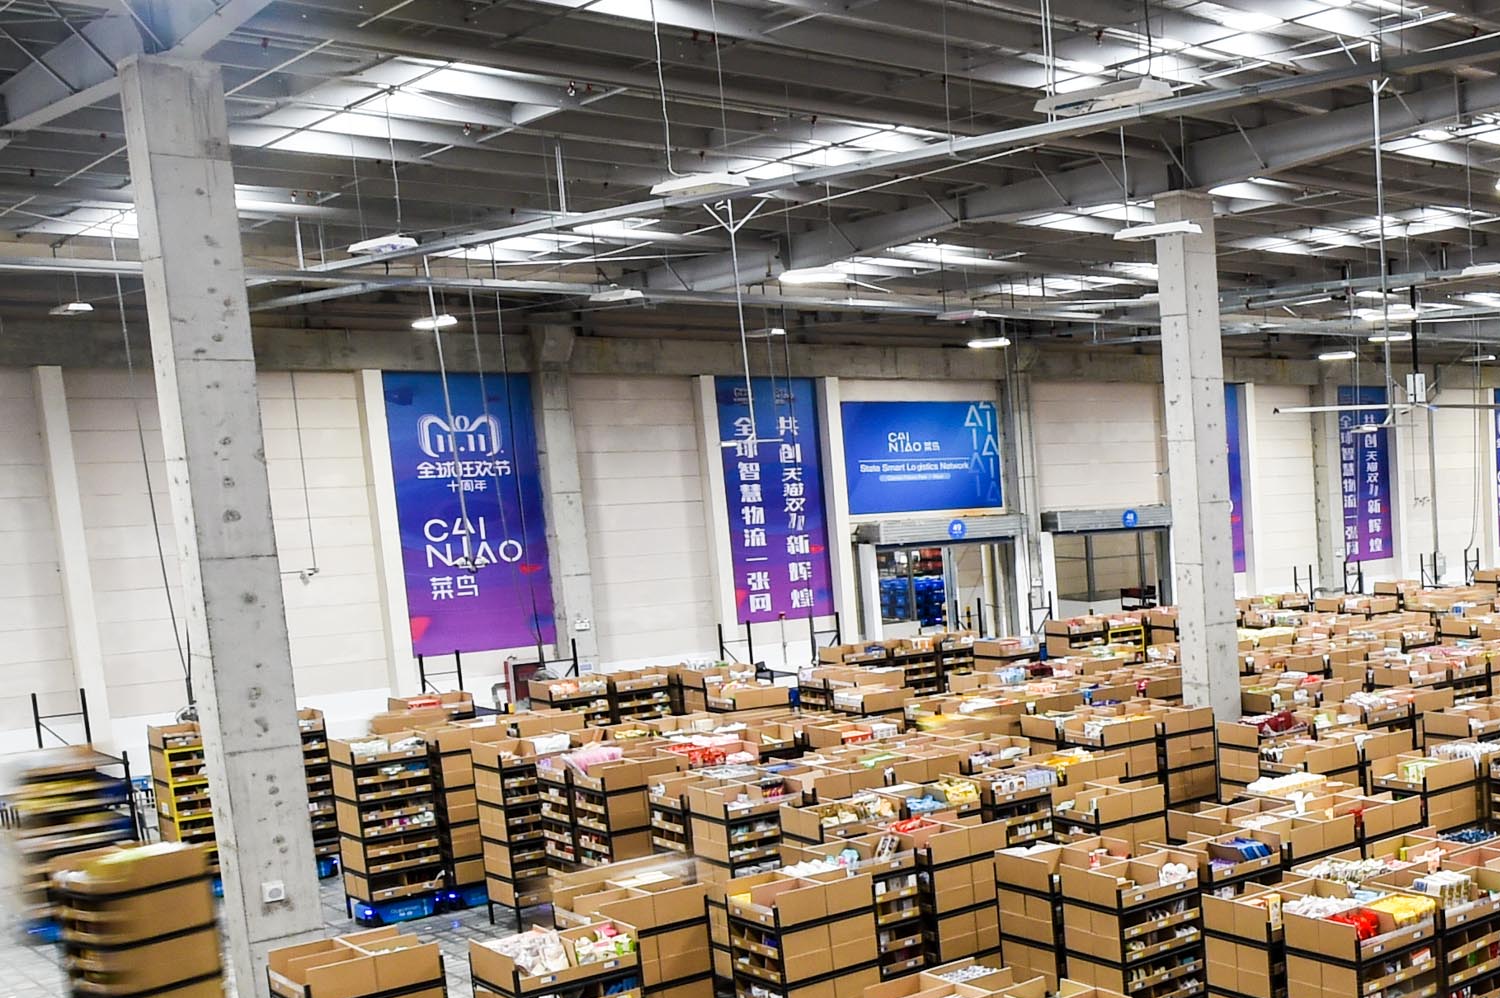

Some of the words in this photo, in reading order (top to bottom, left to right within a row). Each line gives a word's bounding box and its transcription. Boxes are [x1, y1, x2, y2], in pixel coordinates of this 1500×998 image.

[888, 432, 909, 442] CAI
[888, 440, 922, 452] NIAO
[416, 461, 511, 479] 全球狂欢节
[446, 480, 487, 492] 十周年
[734, 416, 772, 613] 全球智慧物流一张网
[423, 516, 486, 543] CAI
[425, 536, 523, 568] NIAO
[429, 575, 479, 600] 菜鸟
